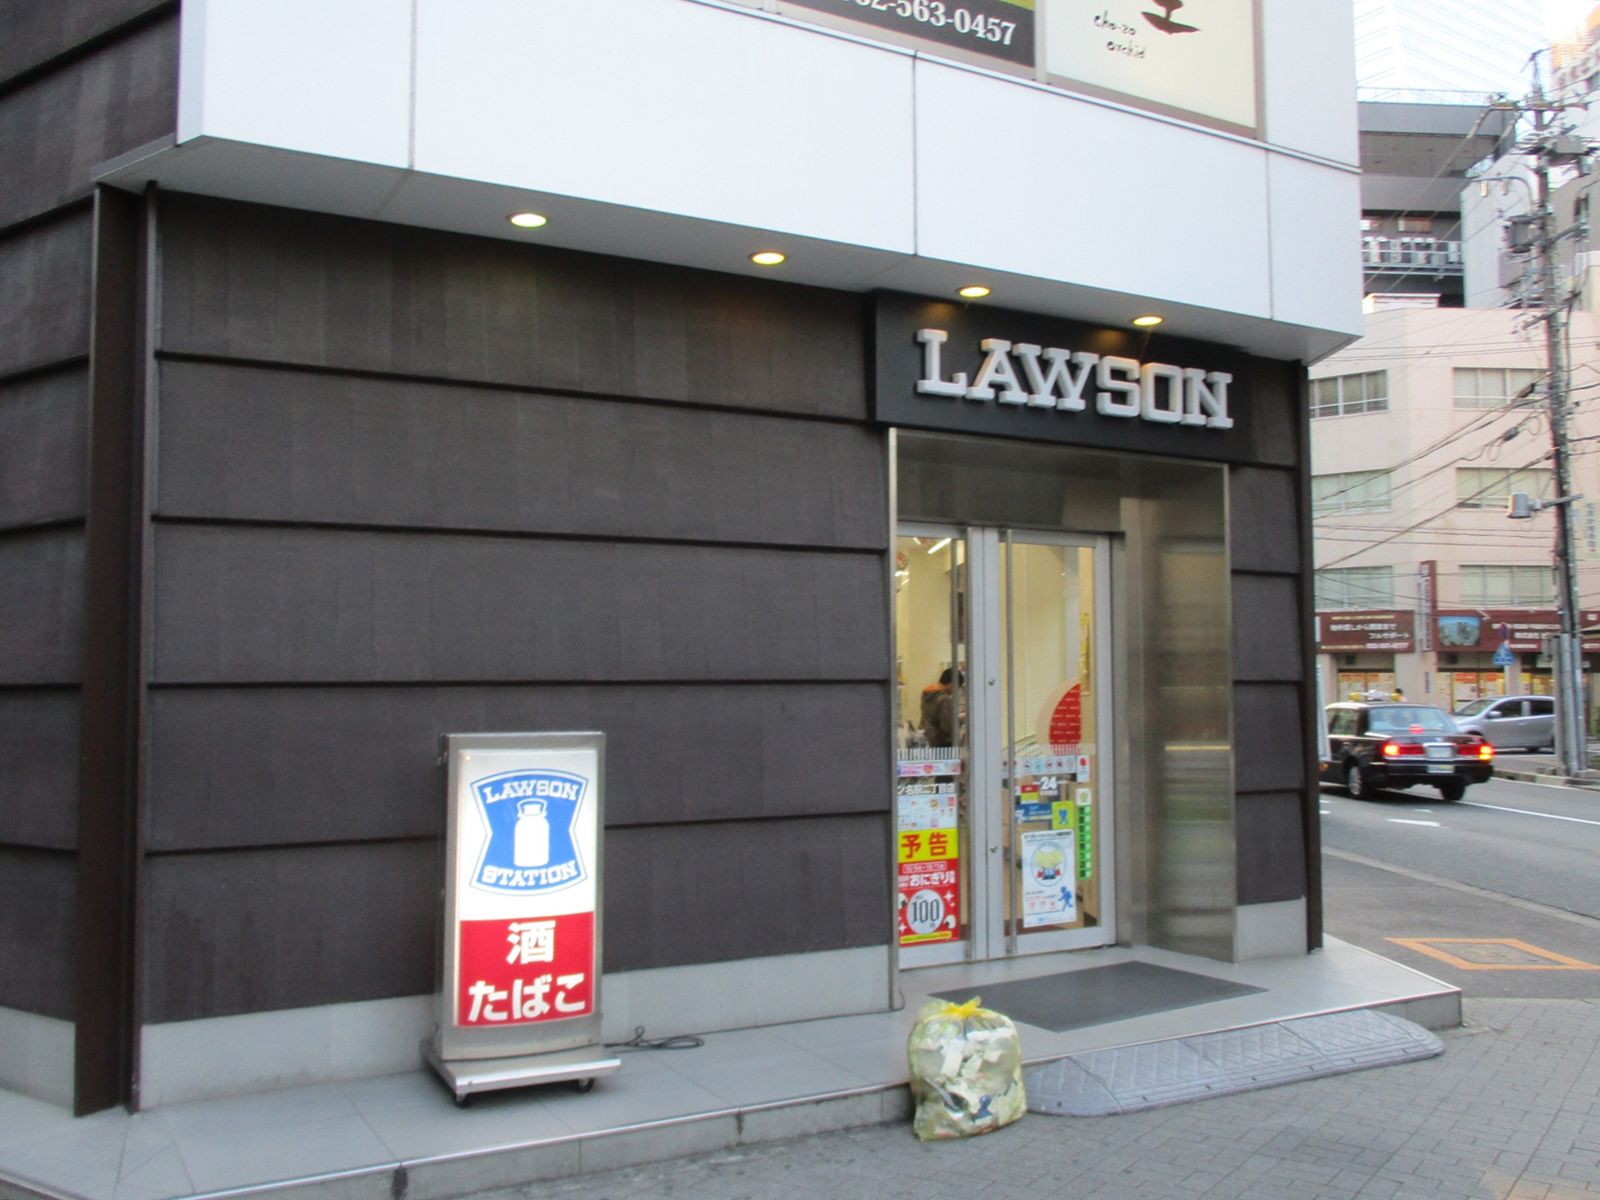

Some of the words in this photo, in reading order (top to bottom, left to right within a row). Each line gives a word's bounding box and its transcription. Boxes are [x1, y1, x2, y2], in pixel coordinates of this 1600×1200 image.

[843, 0, 1017, 46] -563-0457
[917, 328, 1235, 430] LAWSON
[483, 779, 580, 805] LAWSON
[1040, 775, 1058, 791] 24
[900, 832, 949, 859] 予告
[481, 859, 579, 888] STATION
[909, 870, 950, 887] おにぎり
[911, 898, 940, 925] 100
[505, 919, 557, 965] 酒
[467, 972, 586, 1023] たばこ
